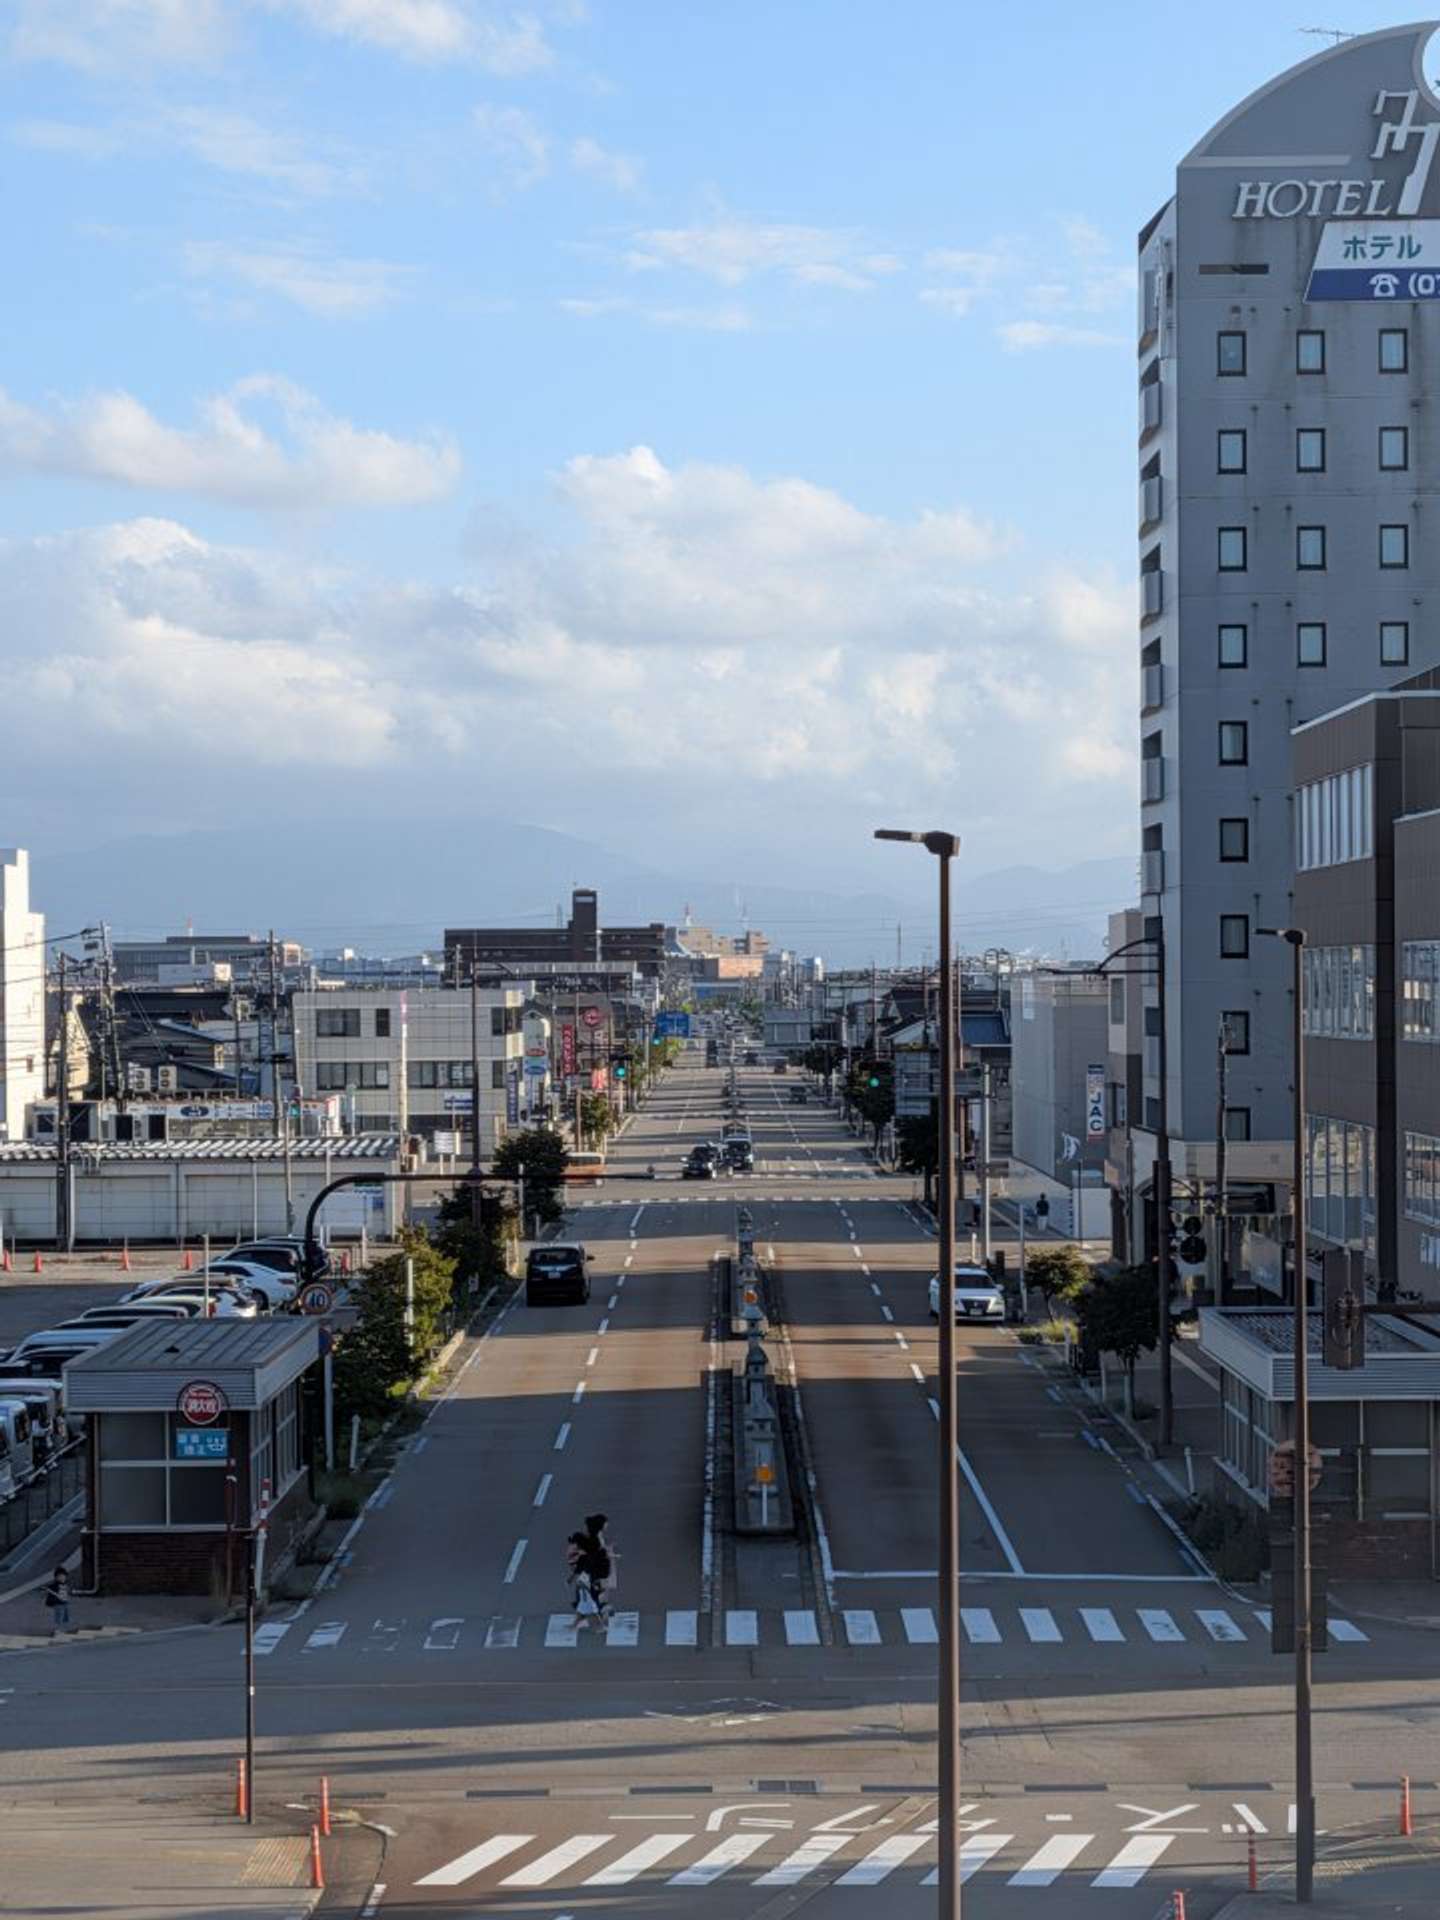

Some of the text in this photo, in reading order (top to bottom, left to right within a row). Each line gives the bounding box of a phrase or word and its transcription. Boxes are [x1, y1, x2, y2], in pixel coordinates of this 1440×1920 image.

[1232, 179, 1392, 219] HOTEL
[1343, 235, 1423, 260] ホテル
